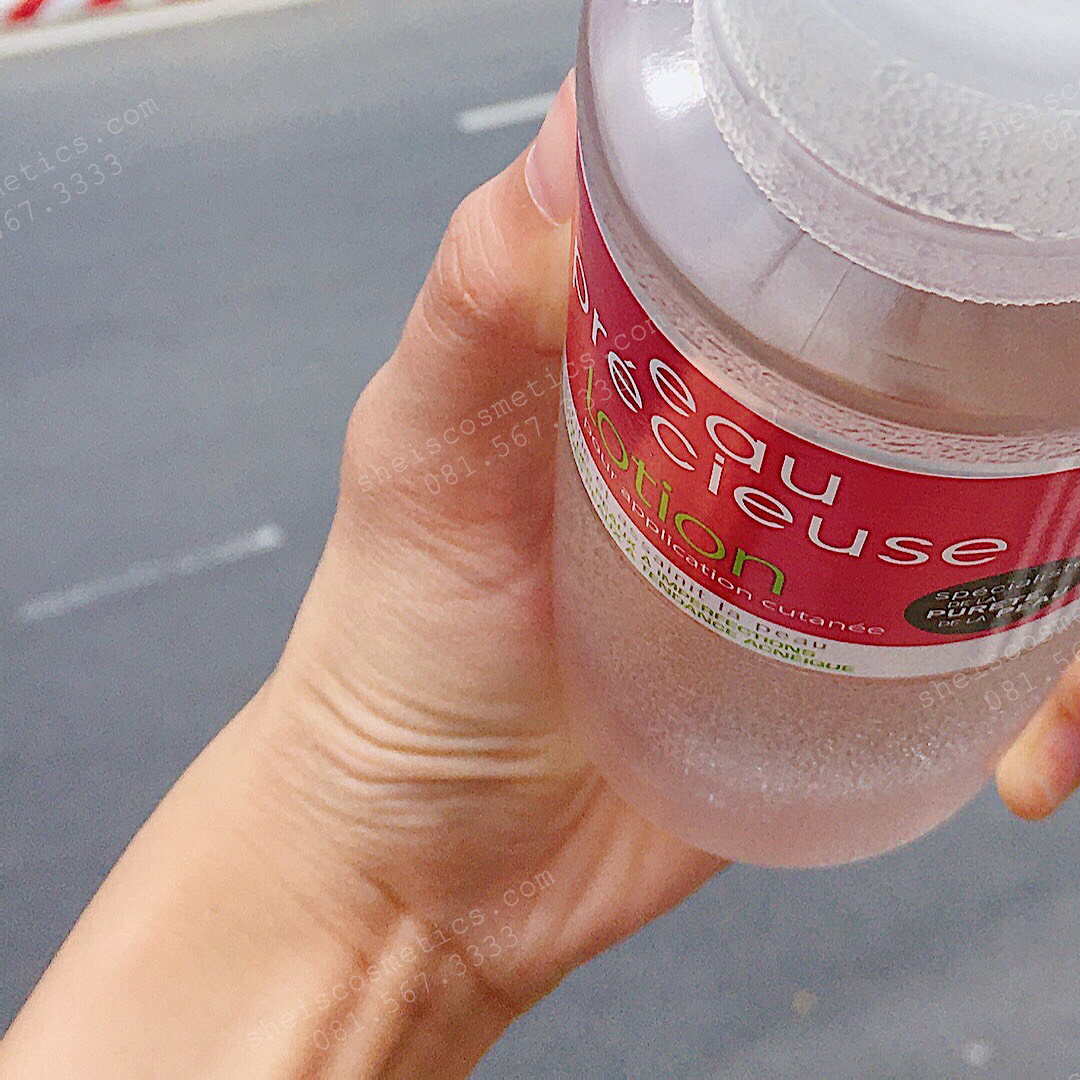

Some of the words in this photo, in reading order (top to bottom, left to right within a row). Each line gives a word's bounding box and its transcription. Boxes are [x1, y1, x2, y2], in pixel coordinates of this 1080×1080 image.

[573, 236, 1008, 566] précieuse
[586, 366, 786, 596] lotion
[650, 357, 843, 508] eau
[583, 416, 618, 480] pour
[620, 486, 753, 601] application
[761, 597, 886, 636] cutanée
